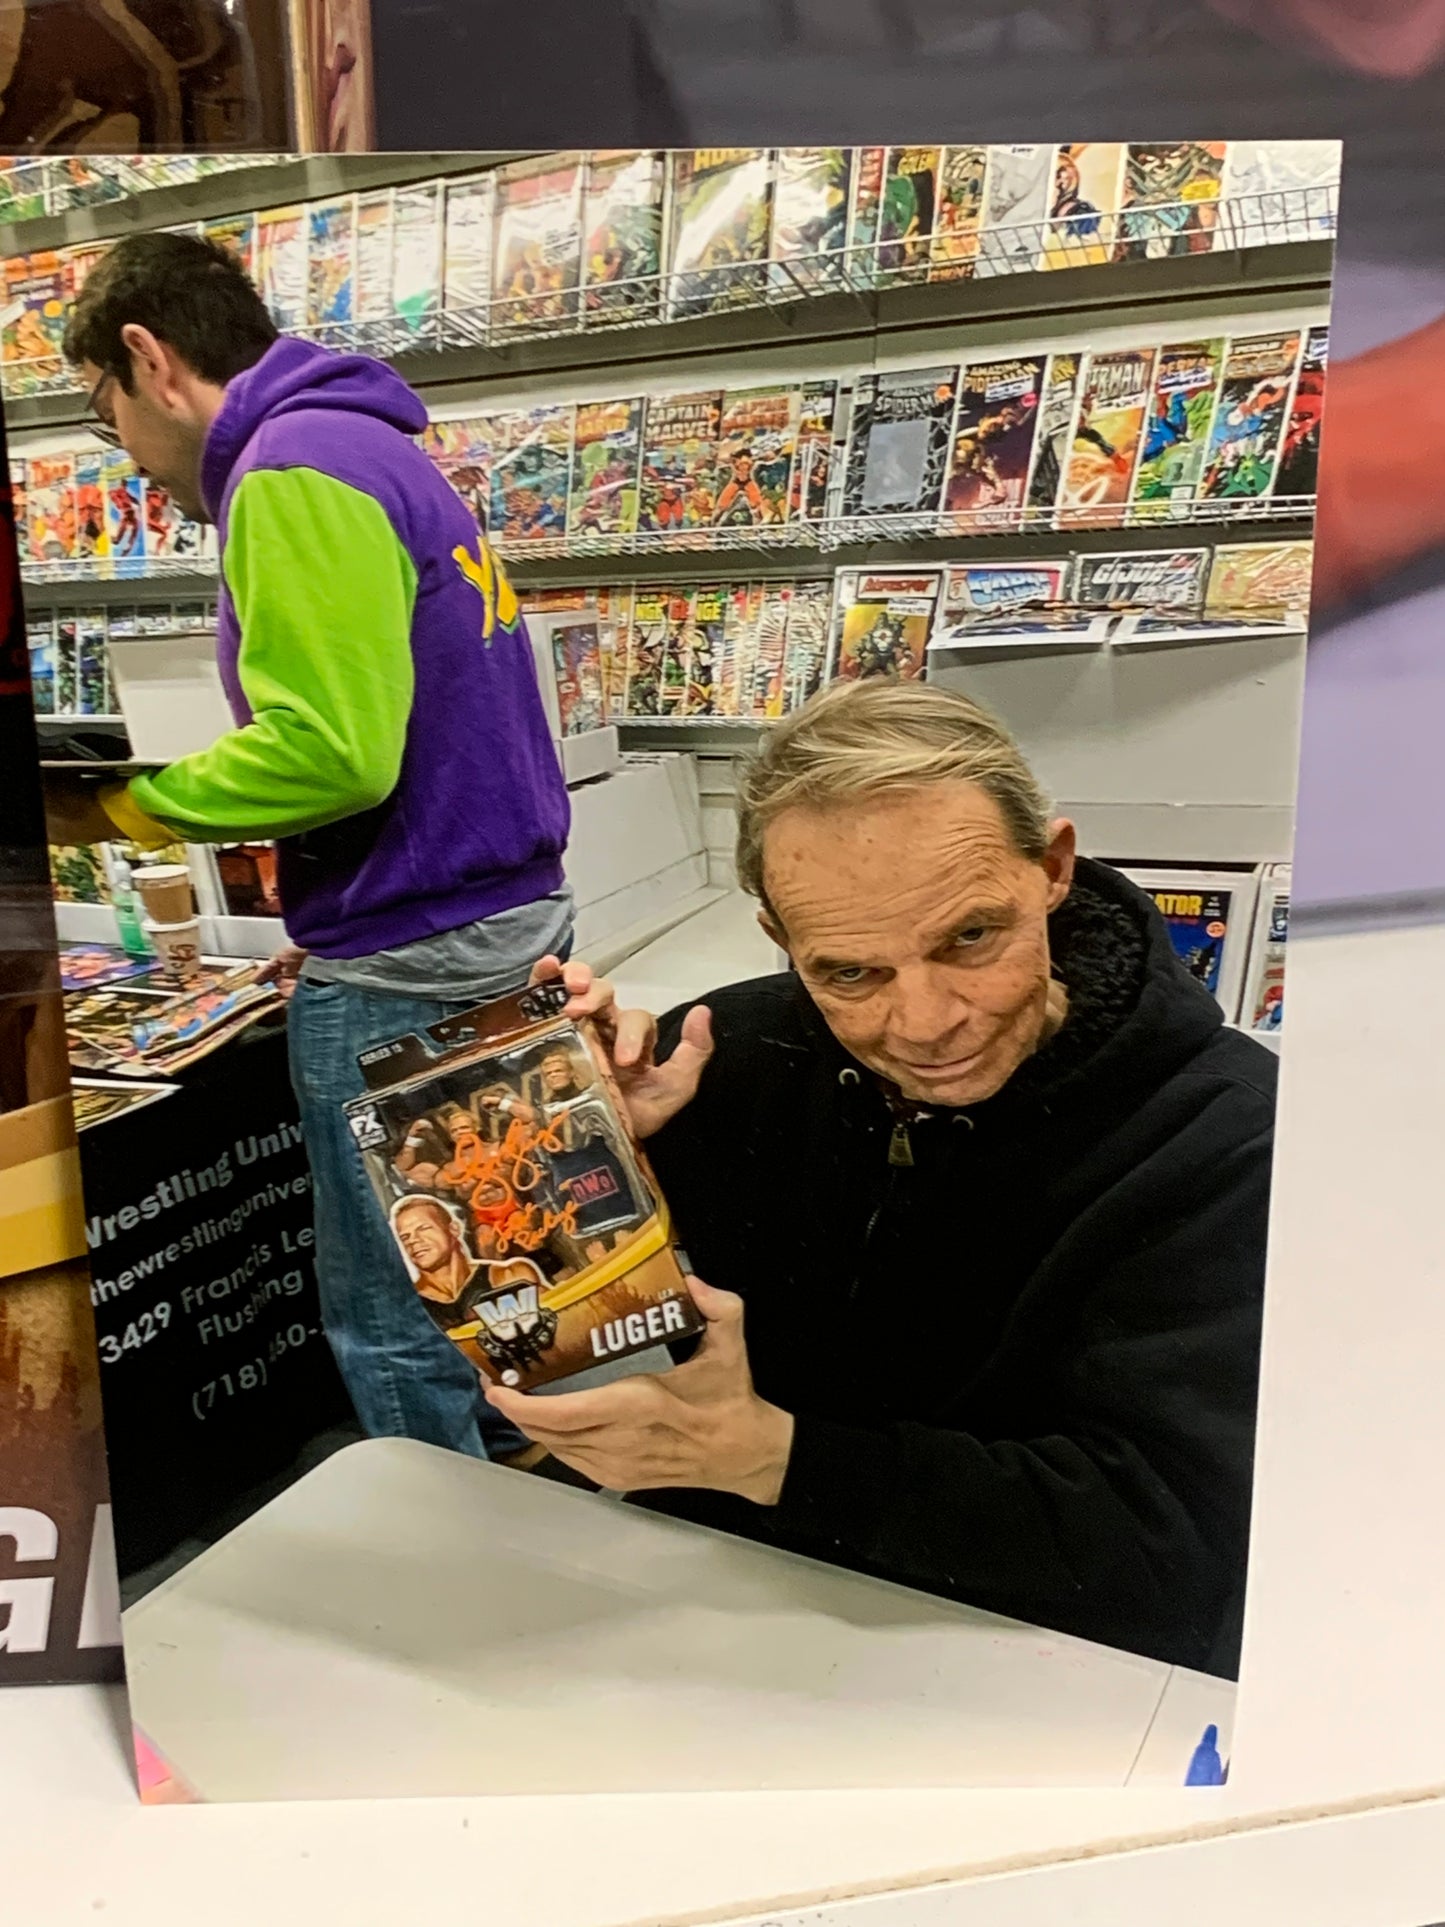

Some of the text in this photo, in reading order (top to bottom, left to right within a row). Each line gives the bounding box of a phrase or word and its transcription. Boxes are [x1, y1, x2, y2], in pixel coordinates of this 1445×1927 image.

[98, 1301, 172, 1364] 3429
[589, 1299, 687, 1358] LUGER
[192, 1357, 268, 1421] (718)
